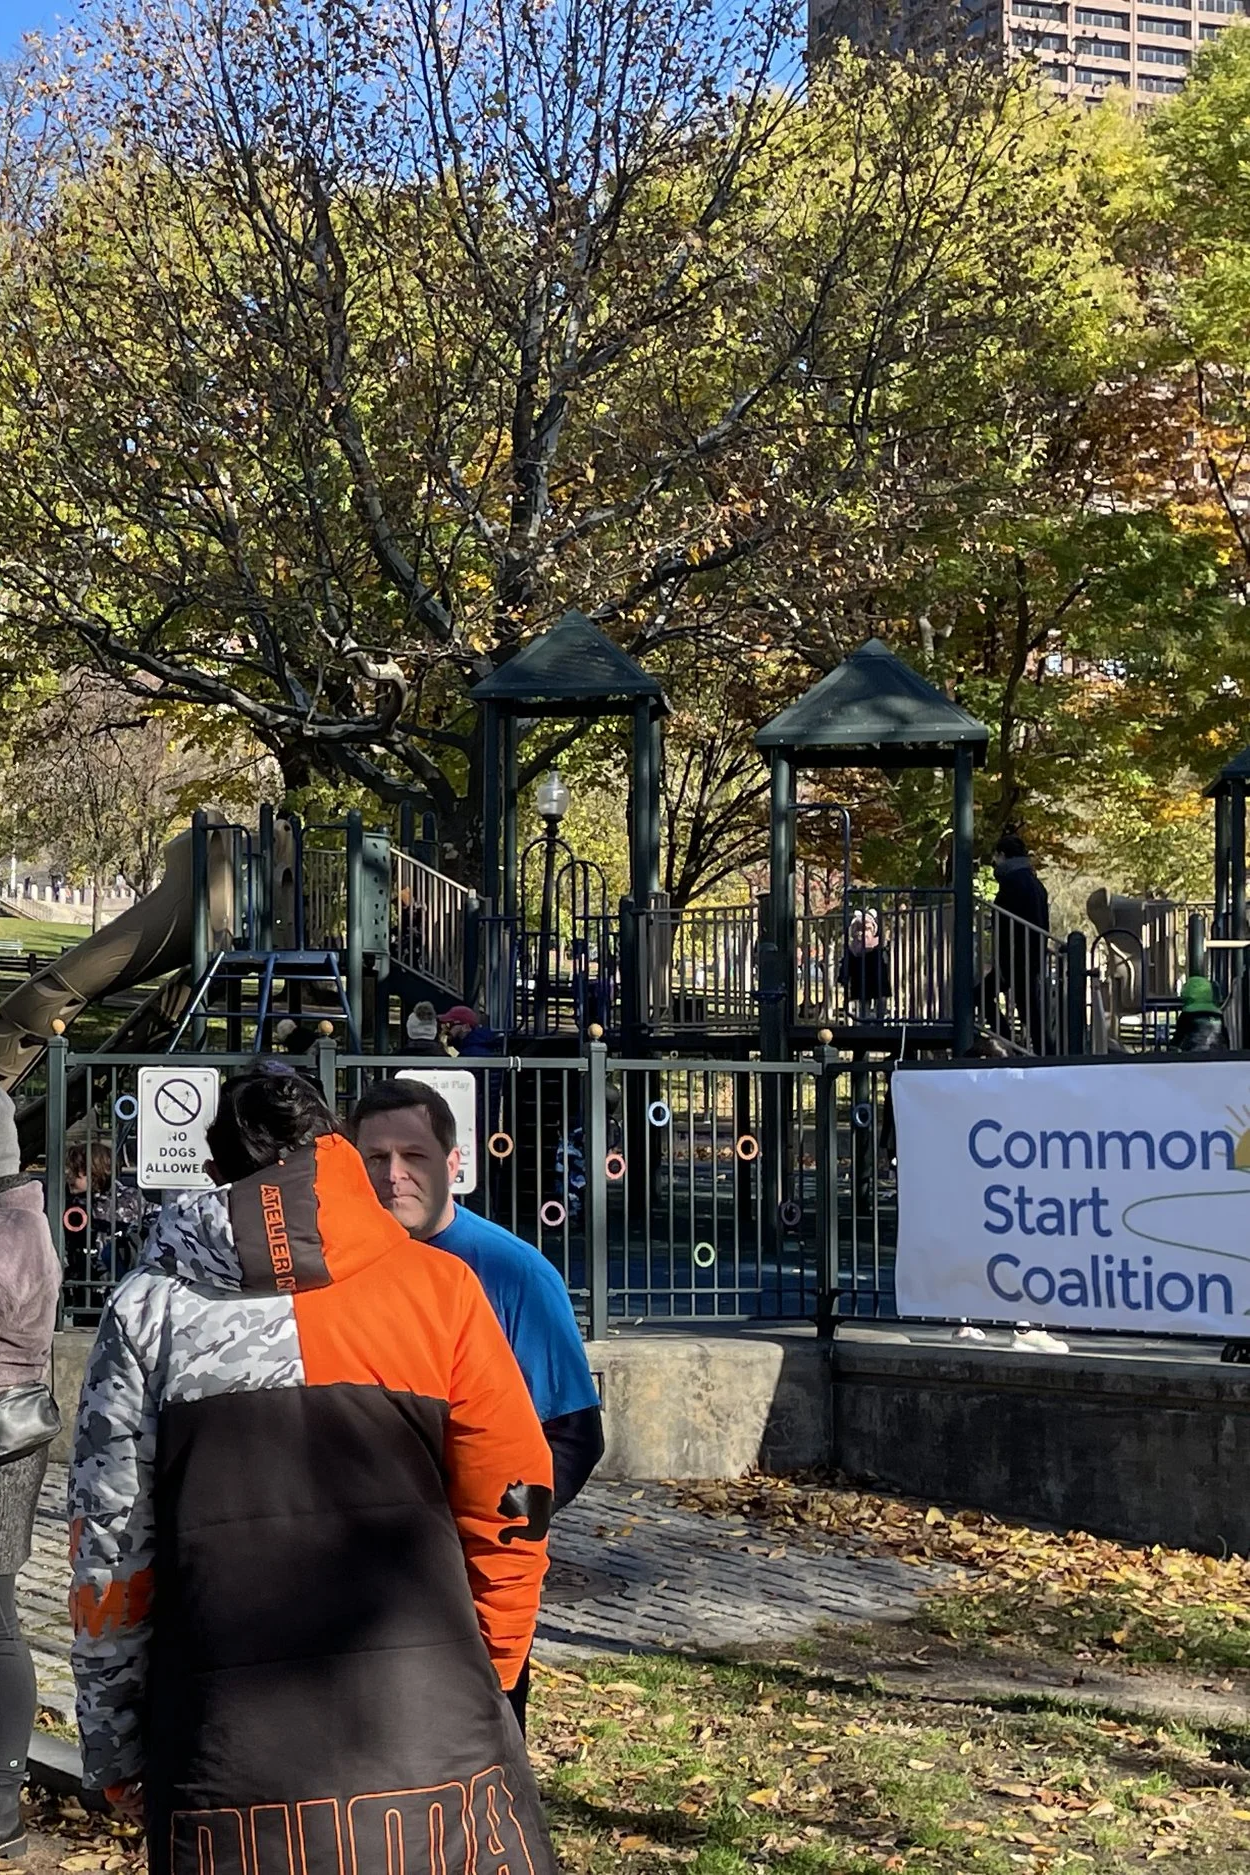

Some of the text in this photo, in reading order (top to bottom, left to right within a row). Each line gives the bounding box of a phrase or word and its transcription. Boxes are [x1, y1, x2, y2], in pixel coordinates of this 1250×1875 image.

[159, 1147, 197, 1158] DOGS
[168, 1131, 188, 1142] NO
[967, 1118, 1236, 1171] Common
[260, 1184, 293, 1275] ATELIER
[983, 1184, 1113, 1238] Start
[986, 1252, 1234, 1316] Coalition
